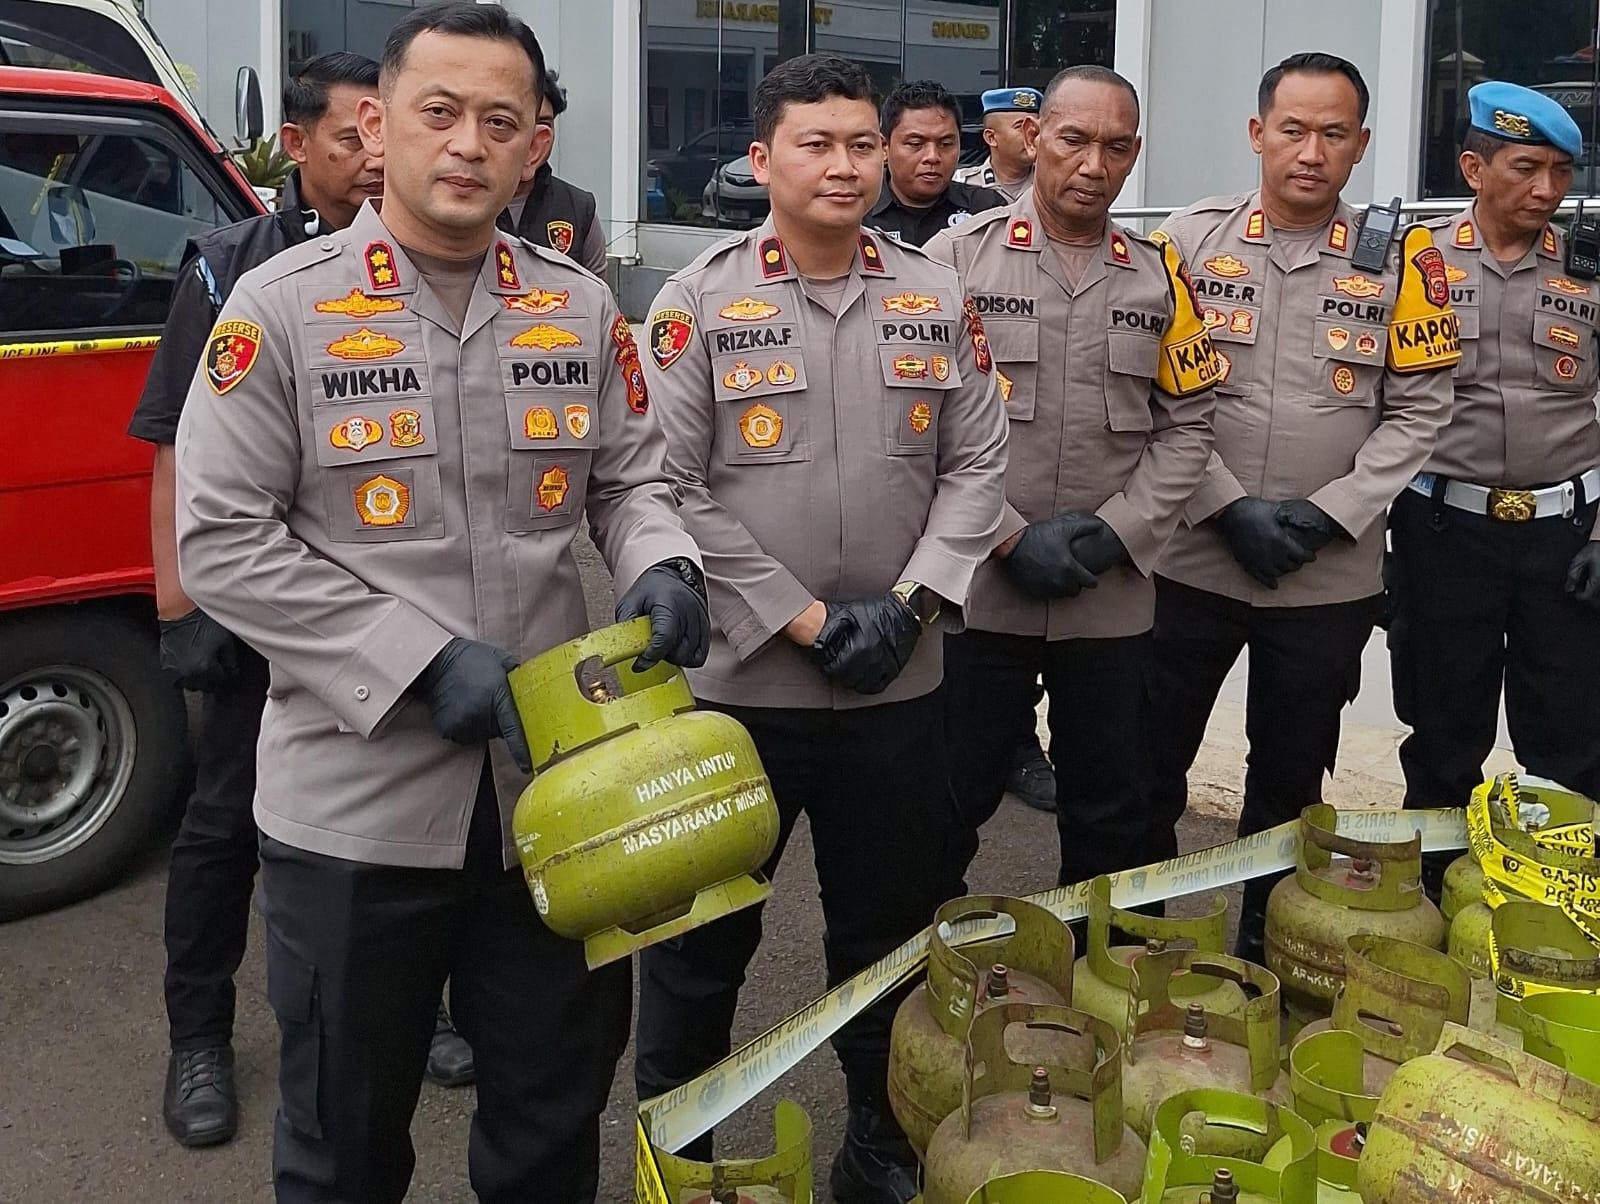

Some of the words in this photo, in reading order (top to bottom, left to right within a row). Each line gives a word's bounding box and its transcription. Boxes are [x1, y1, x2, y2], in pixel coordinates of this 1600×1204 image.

[973, 295, 1034, 315] DISON
[1451, 289, 1475, 303] UT
[1541, 294, 1596, 321] POLRI
[654, 309, 691, 324] RESERSE
[1111, 309, 1165, 335] POLRI
[1322, 298, 1385, 322] POLRI
[214, 320, 259, 340] RESERSE
[716, 327, 792, 353] RIZKA.F
[882, 323, 950, 344] POLRI
[1176, 337, 1212, 374] KAP
[321, 367, 422, 400] WIKHA
[512, 361, 589, 386] POLRI
[636, 766, 696, 804] HANYA
[622, 800, 734, 857] MASYARAKAT
